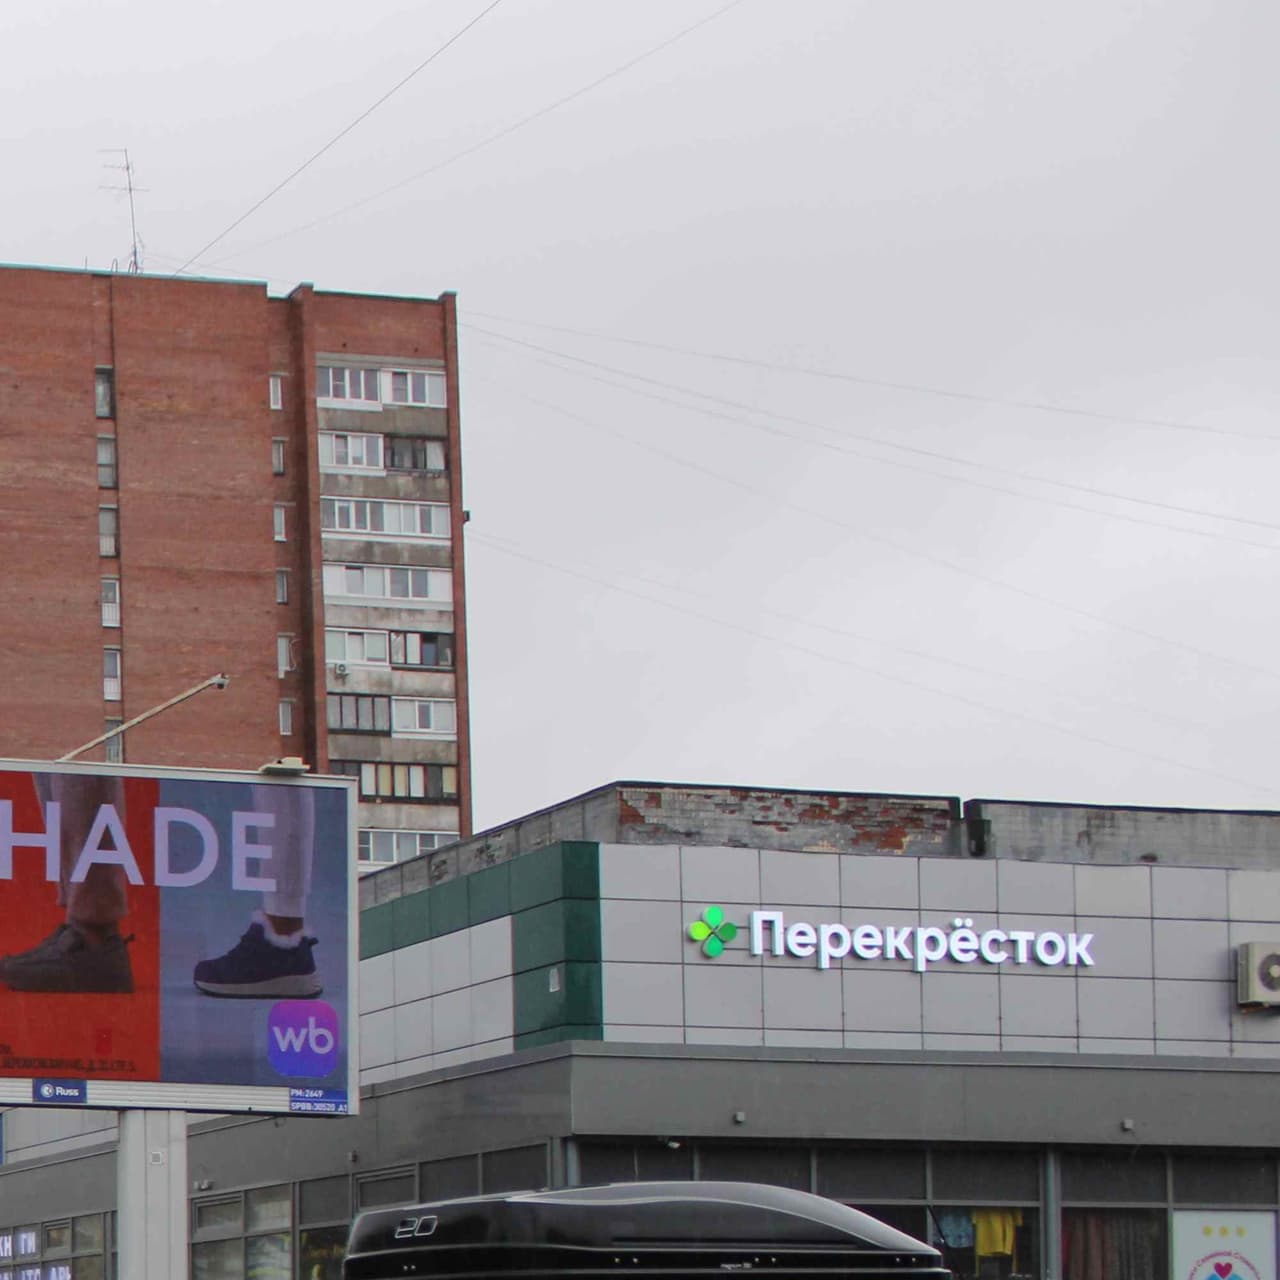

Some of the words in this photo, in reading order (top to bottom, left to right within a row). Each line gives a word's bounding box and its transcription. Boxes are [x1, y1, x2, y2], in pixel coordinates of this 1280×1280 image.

[749, 910, 1095, 973] Перекрёсток
[272, 1016, 335, 1054] wb
[55, 1086, 80, 1097] Russ
